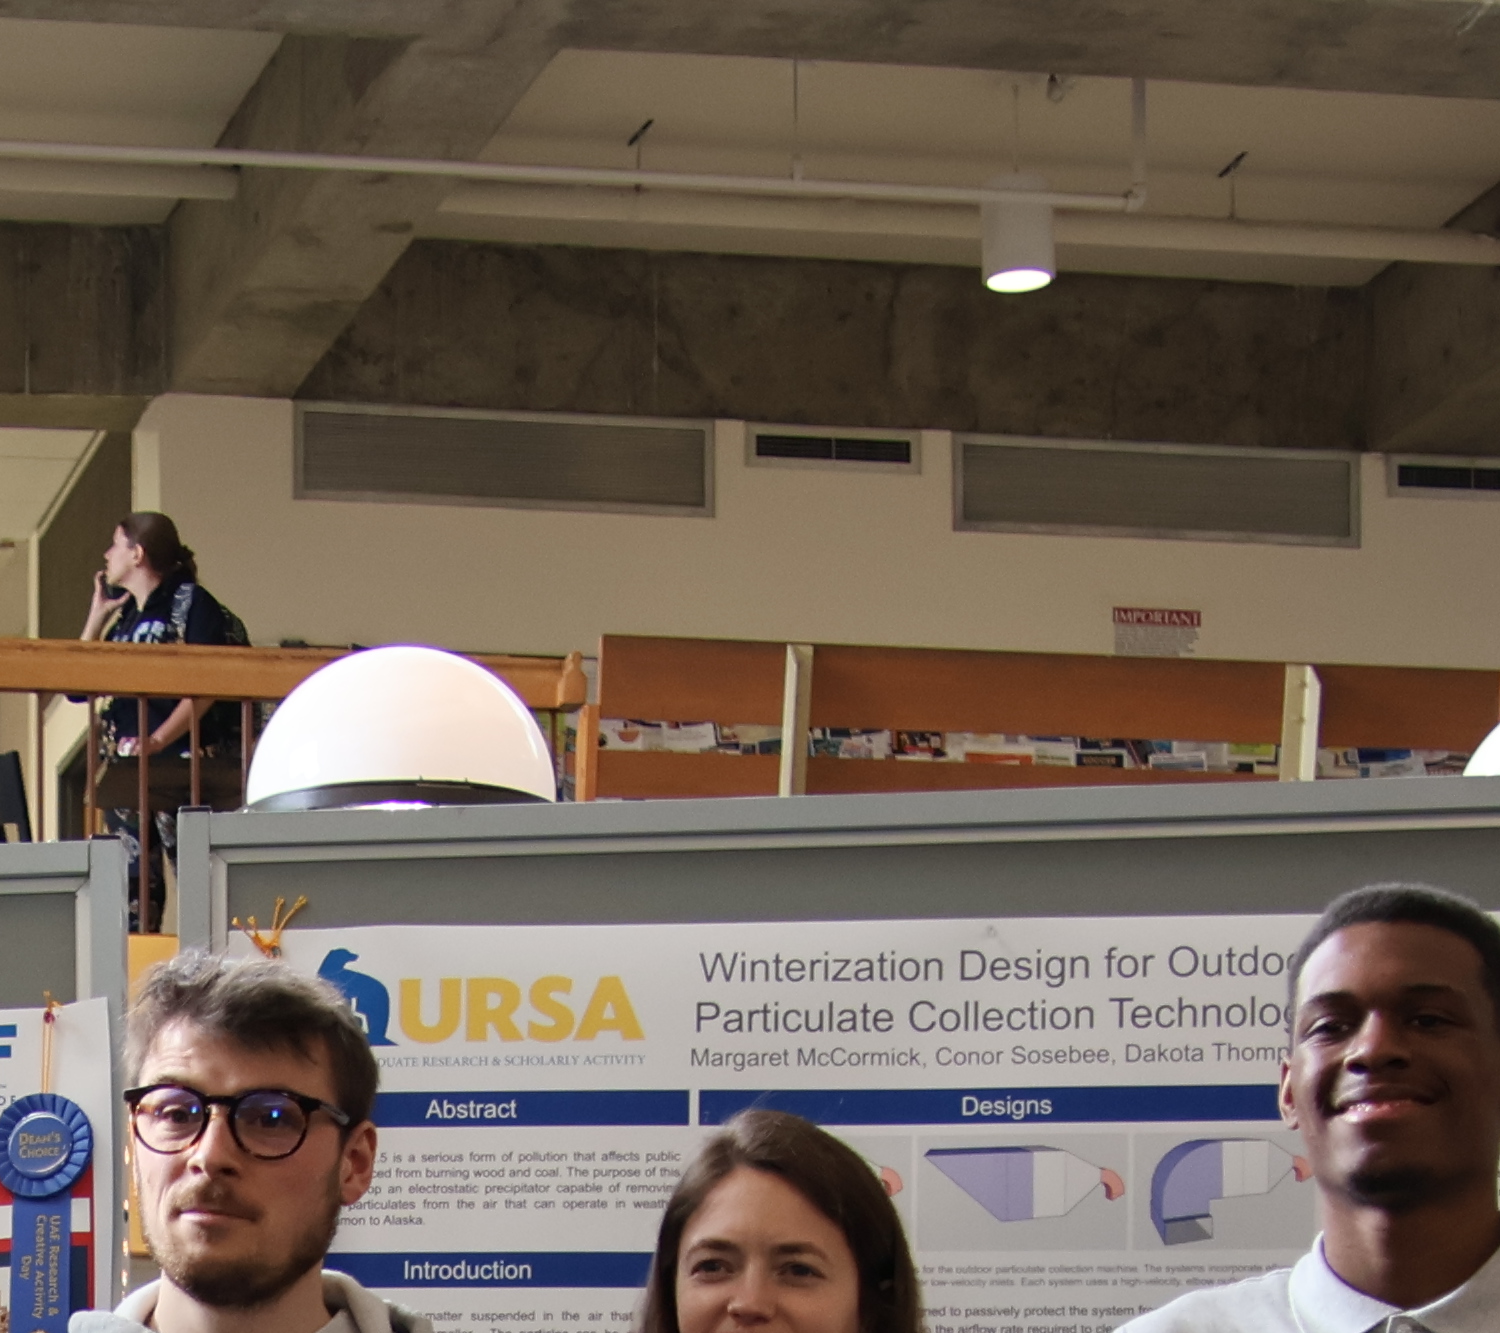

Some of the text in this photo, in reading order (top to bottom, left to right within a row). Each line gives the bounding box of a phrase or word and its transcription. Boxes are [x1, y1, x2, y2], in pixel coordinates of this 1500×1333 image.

[700, 951, 943, 982] Winterization
[960, 949, 1089, 984] Design
[1104, 947, 1152, 978] for
[400, 976, 645, 1043] URSA
[696, 1001, 893, 1033] Particulate
[909, 999, 1094, 1032] Collection
[422, 1056, 488, 1067] RESEARCH
[504, 1055, 579, 1066] SCHOLARLY
[583, 1055, 645, 1065] ACTIVITY
[691, 1043, 1285, 1072] Margaret McCormick, Conor Sosebee, Dakota Thomp
[426, 1100, 517, 1119] Abstract
[962, 1096, 1052, 1120] Designs
[20, 1255, 31, 1279] Day
[33, 1215, 47, 1318] Creative Activity
[50, 1246, 60, 1302] Research
[404, 1260, 531, 1280] Introduction
